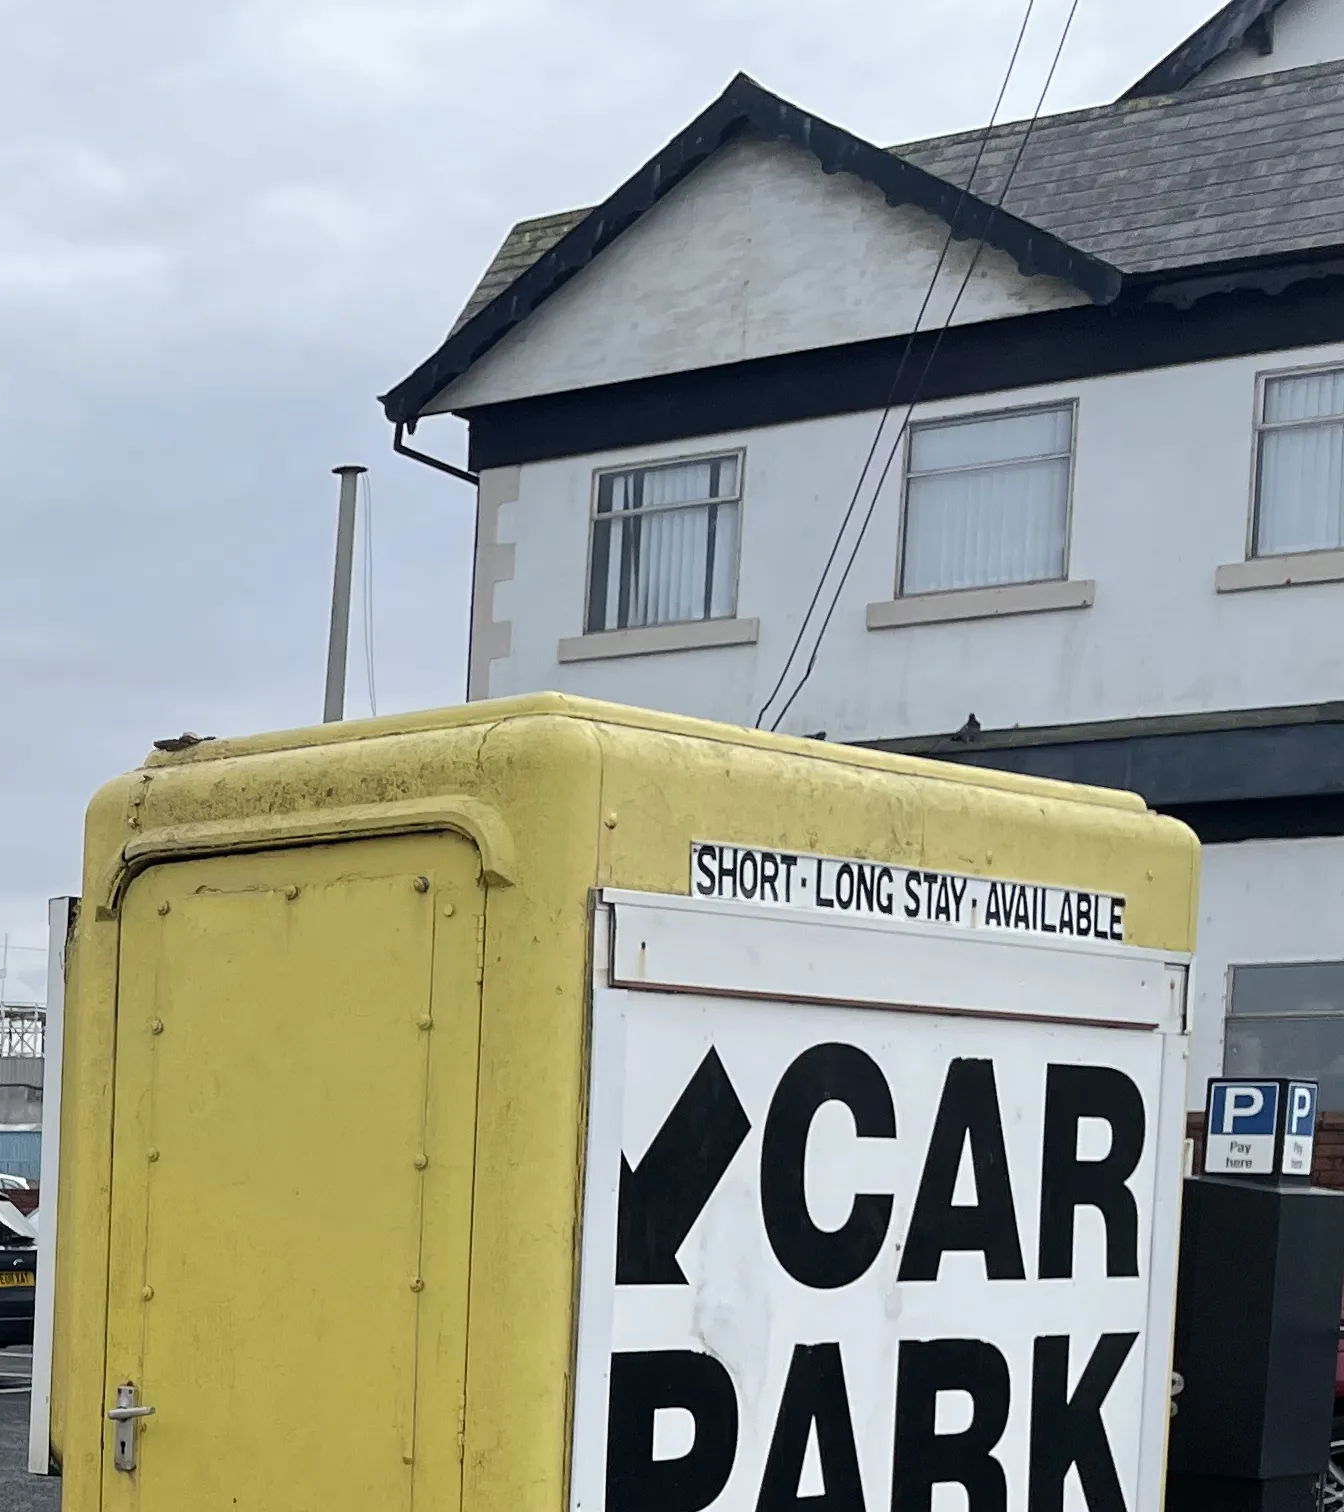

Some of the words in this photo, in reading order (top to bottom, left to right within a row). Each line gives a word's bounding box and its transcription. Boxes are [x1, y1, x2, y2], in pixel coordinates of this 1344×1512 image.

[695, 845, 797, 902] SHORT
[816, 858, 893, 914] LONG
[903, 870, 967, 922] STAY
[984, 882, 1126, 941] AVAILABLE
[1223, 1087, 1264, 1133] P
[1292, 1087, 1311, 1133] P
[760, 1041, 1146, 1290] CAR
[1226, 1156, 1252, 1168] here
[1230, 1140, 1252, 1155] Pay
